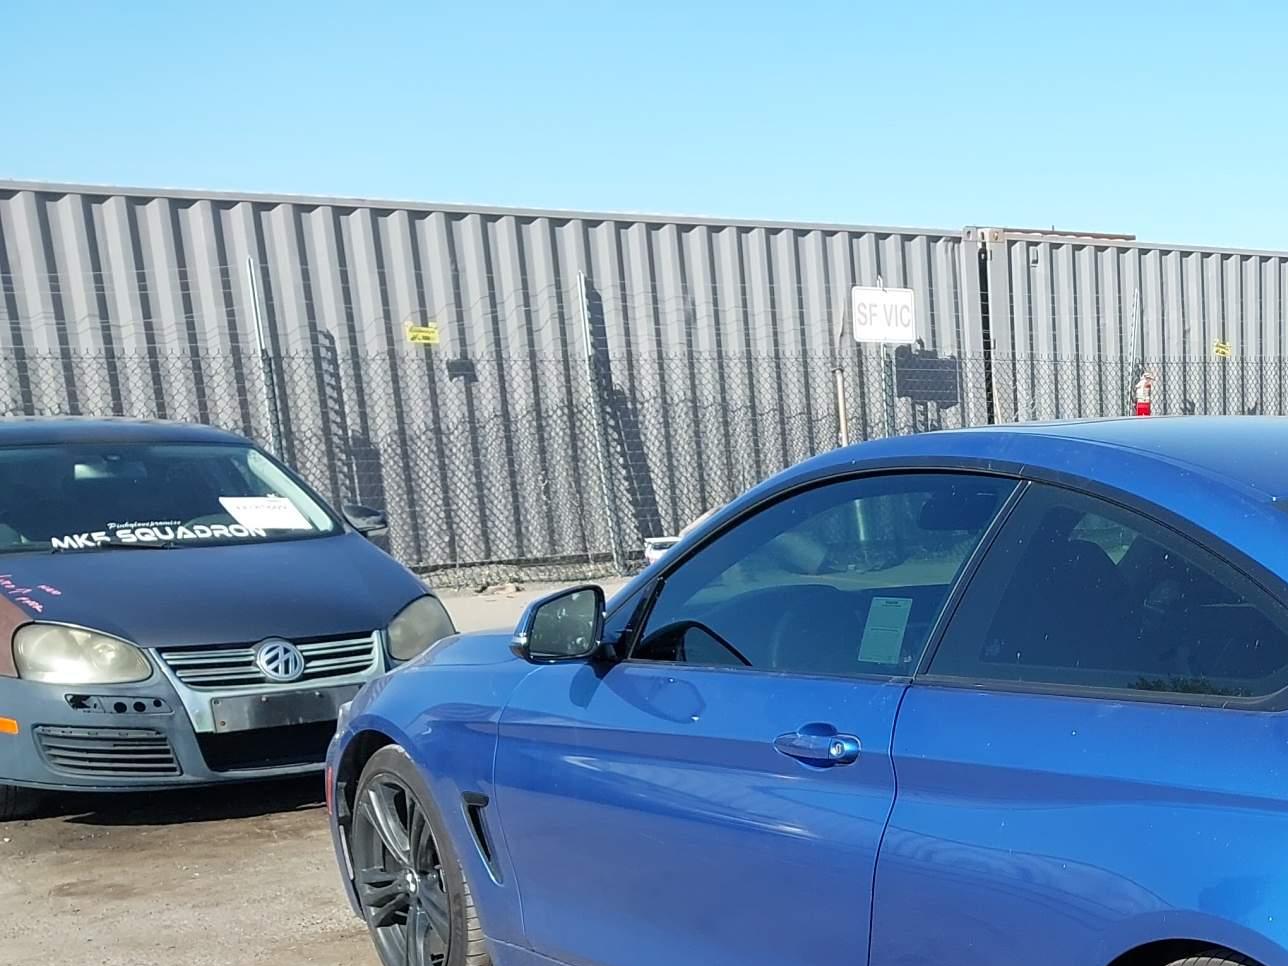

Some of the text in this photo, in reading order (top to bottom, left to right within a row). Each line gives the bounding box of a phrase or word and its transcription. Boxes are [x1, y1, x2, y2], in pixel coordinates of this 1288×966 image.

[857, 302, 912, 329] SF VIC
[115, 523, 268, 543] SQUADRON
